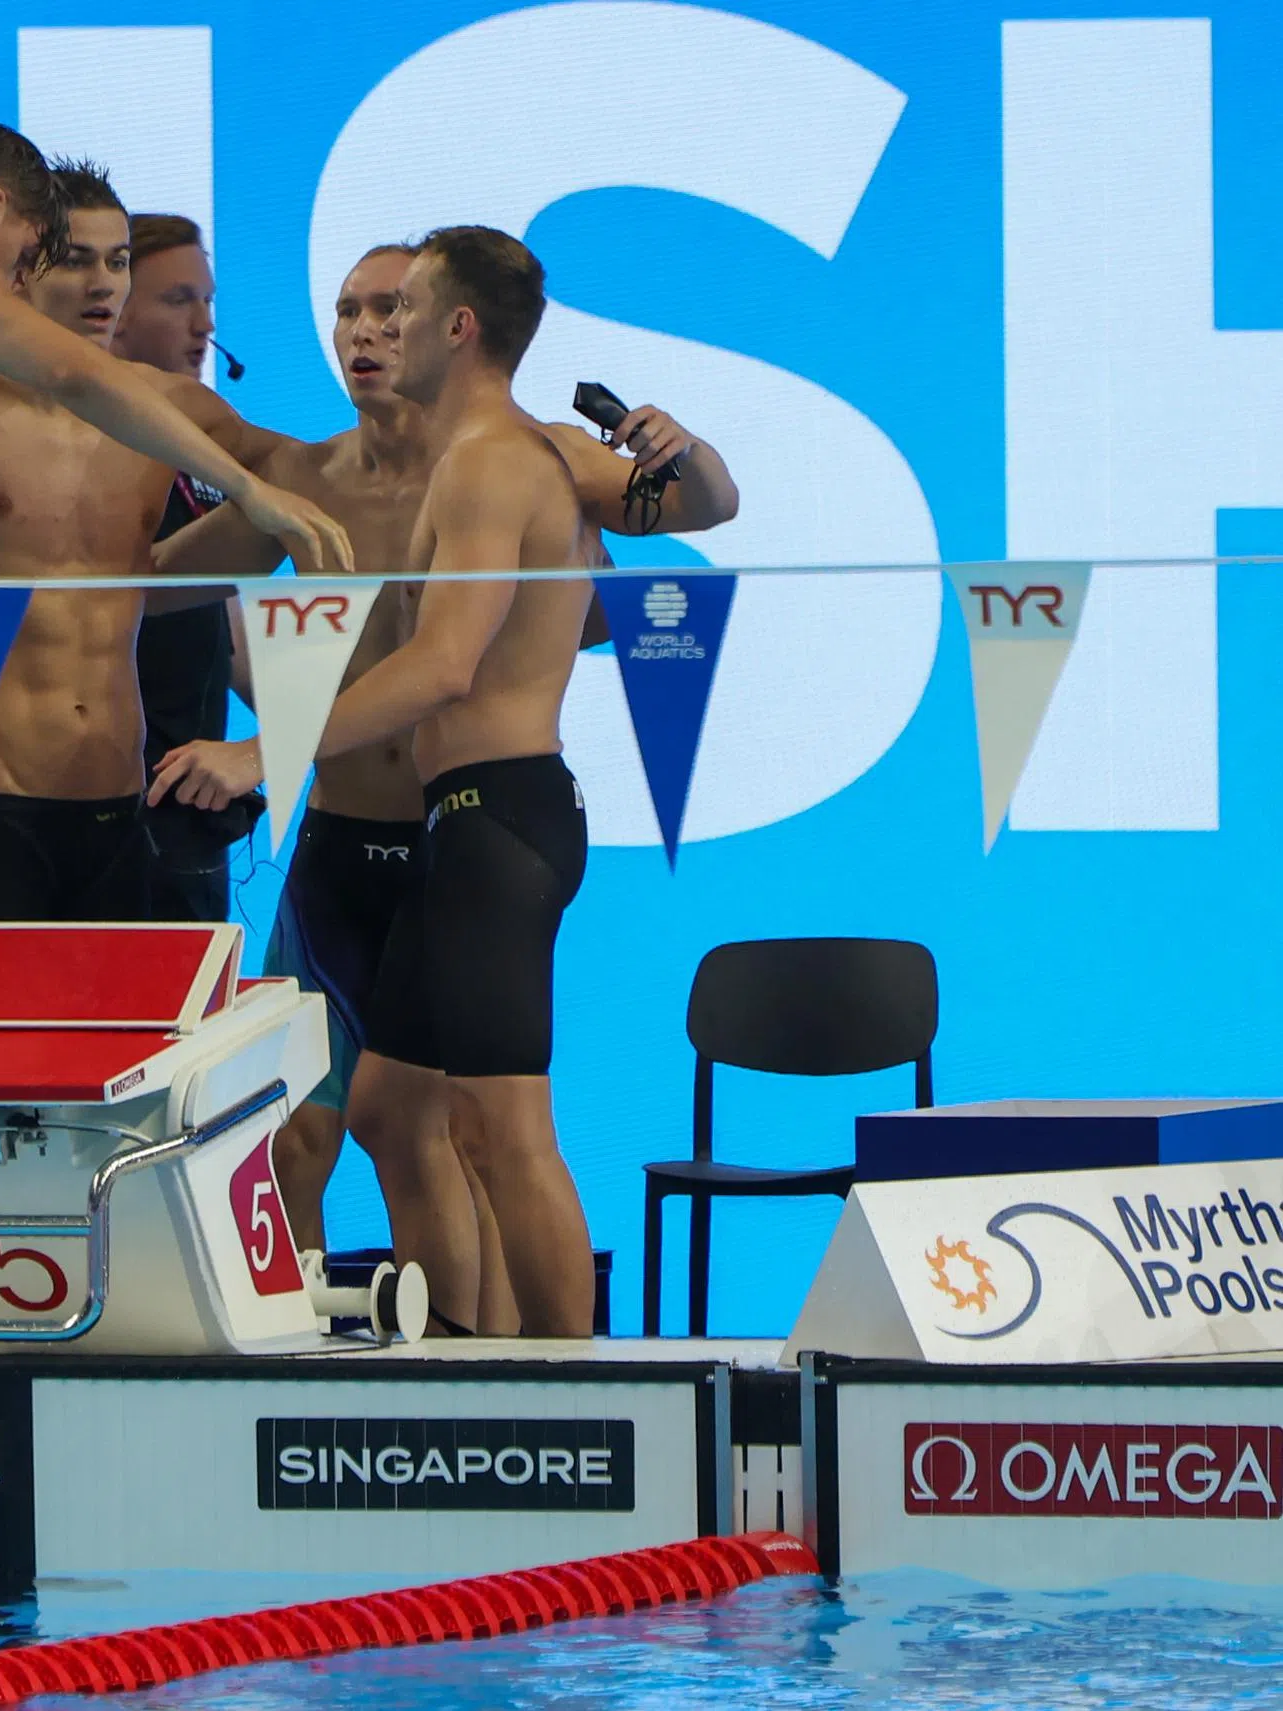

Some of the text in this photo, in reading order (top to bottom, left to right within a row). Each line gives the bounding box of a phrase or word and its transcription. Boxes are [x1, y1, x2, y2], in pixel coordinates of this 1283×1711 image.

[259, 596, 349, 637] TYR
[968, 585, 1064, 627] TYR
[629, 646, 706, 660] AQUATICS
[638, 634, 696, 647] WORLD
[363, 844, 410, 861] TYR
[251, 1181, 272, 1272] 5
[1112, 1188, 1283, 1263] Myrth
[1141, 1255, 1283, 1318] Pools
[279, 1448, 613, 1485] SINGAPORE
[1000, 1441, 1278, 1504] OMEGA
